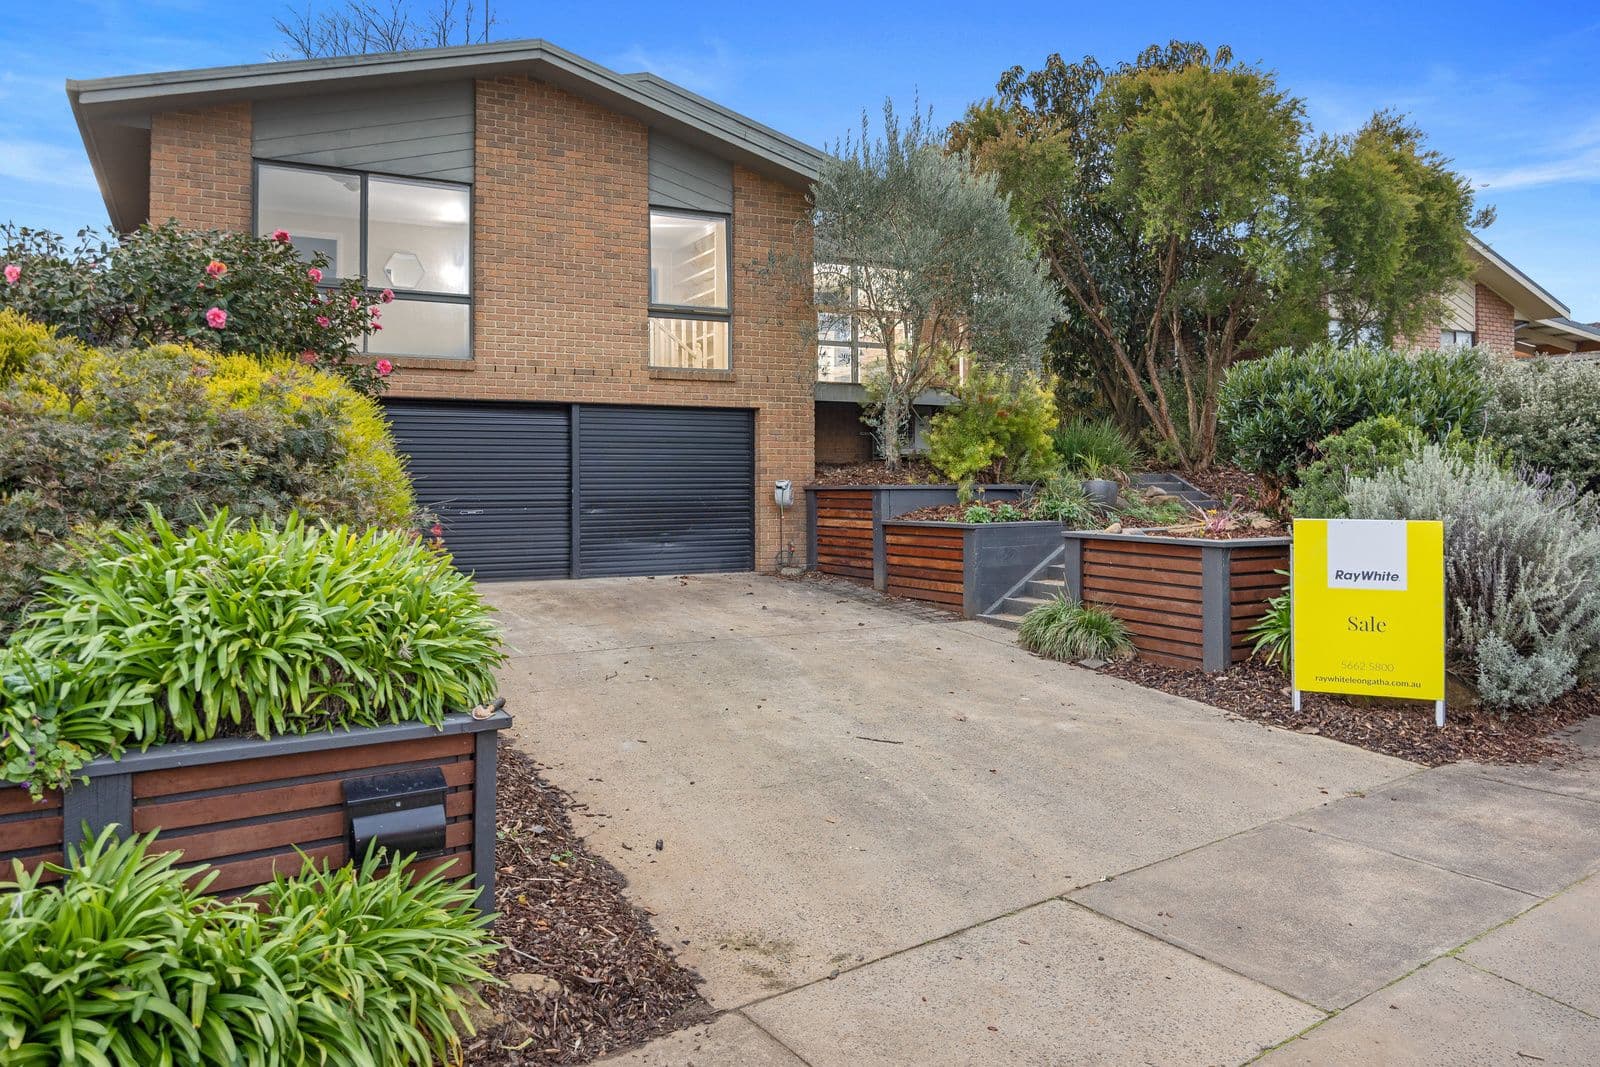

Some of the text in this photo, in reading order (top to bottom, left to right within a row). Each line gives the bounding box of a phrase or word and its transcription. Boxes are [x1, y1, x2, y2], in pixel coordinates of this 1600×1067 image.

[1347, 616, 1387, 633] Sale
[1341, 661, 1395, 672] 5662 5800
[1315, 675, 1421, 688] raywhiteleongatha.com.au
